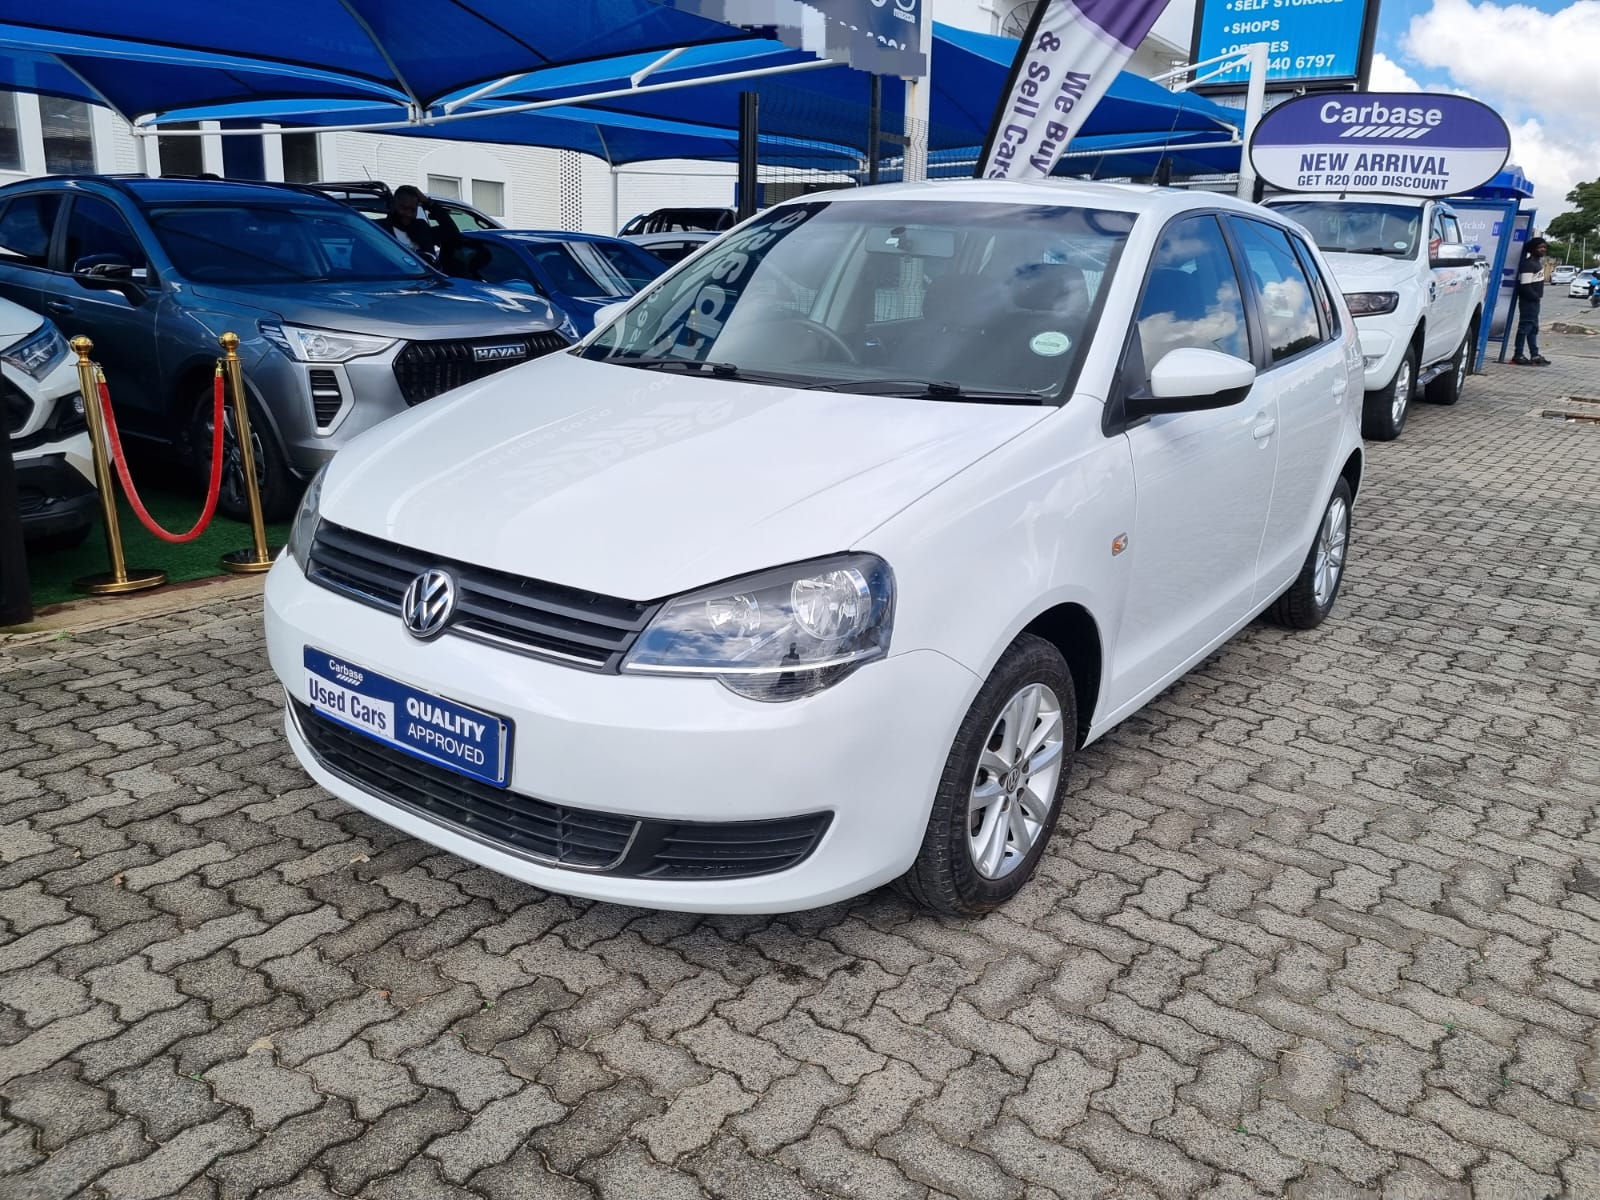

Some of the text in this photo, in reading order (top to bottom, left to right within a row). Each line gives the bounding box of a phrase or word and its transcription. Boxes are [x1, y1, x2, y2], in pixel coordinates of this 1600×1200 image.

[1234, 0, 1269, 11] SELF
[1232, 19, 1280, 34] SHOPS
[1037, 31, 1061, 52] &
[1295, 54, 1336, 68] 6797
[1013, 61, 1051, 119] Sell
[1029, 71, 1091, 174] We Buy
[1320, 101, 1443, 126] Carbase
[1300, 153, 1449, 176] NEW ARRIVAL
[1298, 174, 1448, 190] GET R20 000 DISCOUNT
[476, 346, 525, 359] HAVAL
[329, 659, 364, 682] Carbase
[309, 678, 387, 730] Used Cars
[406, 697, 486, 742] QUALITY
[407, 722, 485, 766] APPROVED
